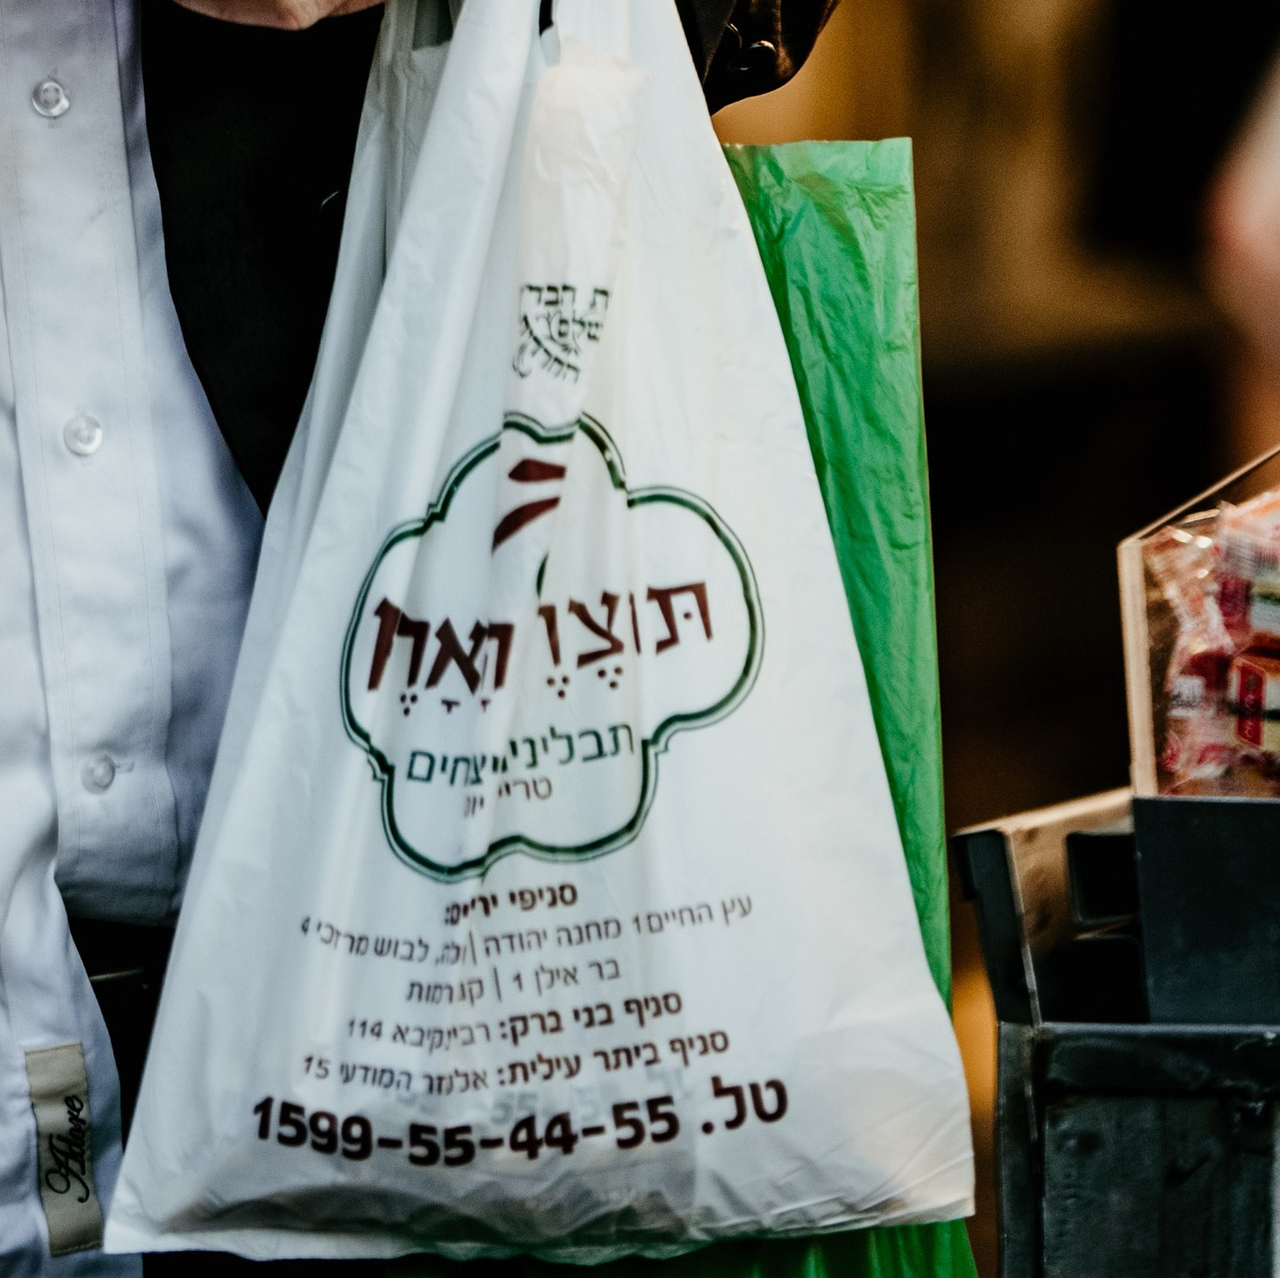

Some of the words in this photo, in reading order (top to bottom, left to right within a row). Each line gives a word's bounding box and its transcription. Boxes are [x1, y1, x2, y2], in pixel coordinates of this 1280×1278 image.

[509, 883, 578, 912] סניפי
[721, 894, 752, 925] עץ
[556, 918, 622, 948] מחנה
[646, 902, 714, 934] החיים
[374, 937, 429, 962] לבוש
[483, 927, 548, 958] יהודה
[513, 972, 524, 992] 1
[534, 963, 579, 996] אילן
[588, 958, 621, 981] בר
[573, 1002, 615, 1029] בני
[624, 991, 683, 1029] סניף
[348, 1017, 384, 1039] 114
[499, 1010, 565, 1047] ברק:
[593, 1043, 660, 1072] ביתר
[669, 1030, 730, 1068] סניף
[304, 1055, 333, 1080] 15
[497, 1054, 582, 1086] עילית:
[700, 1076, 789, 1137] טל.
[253, 1096, 681, 1166] 1599-55-44-55
